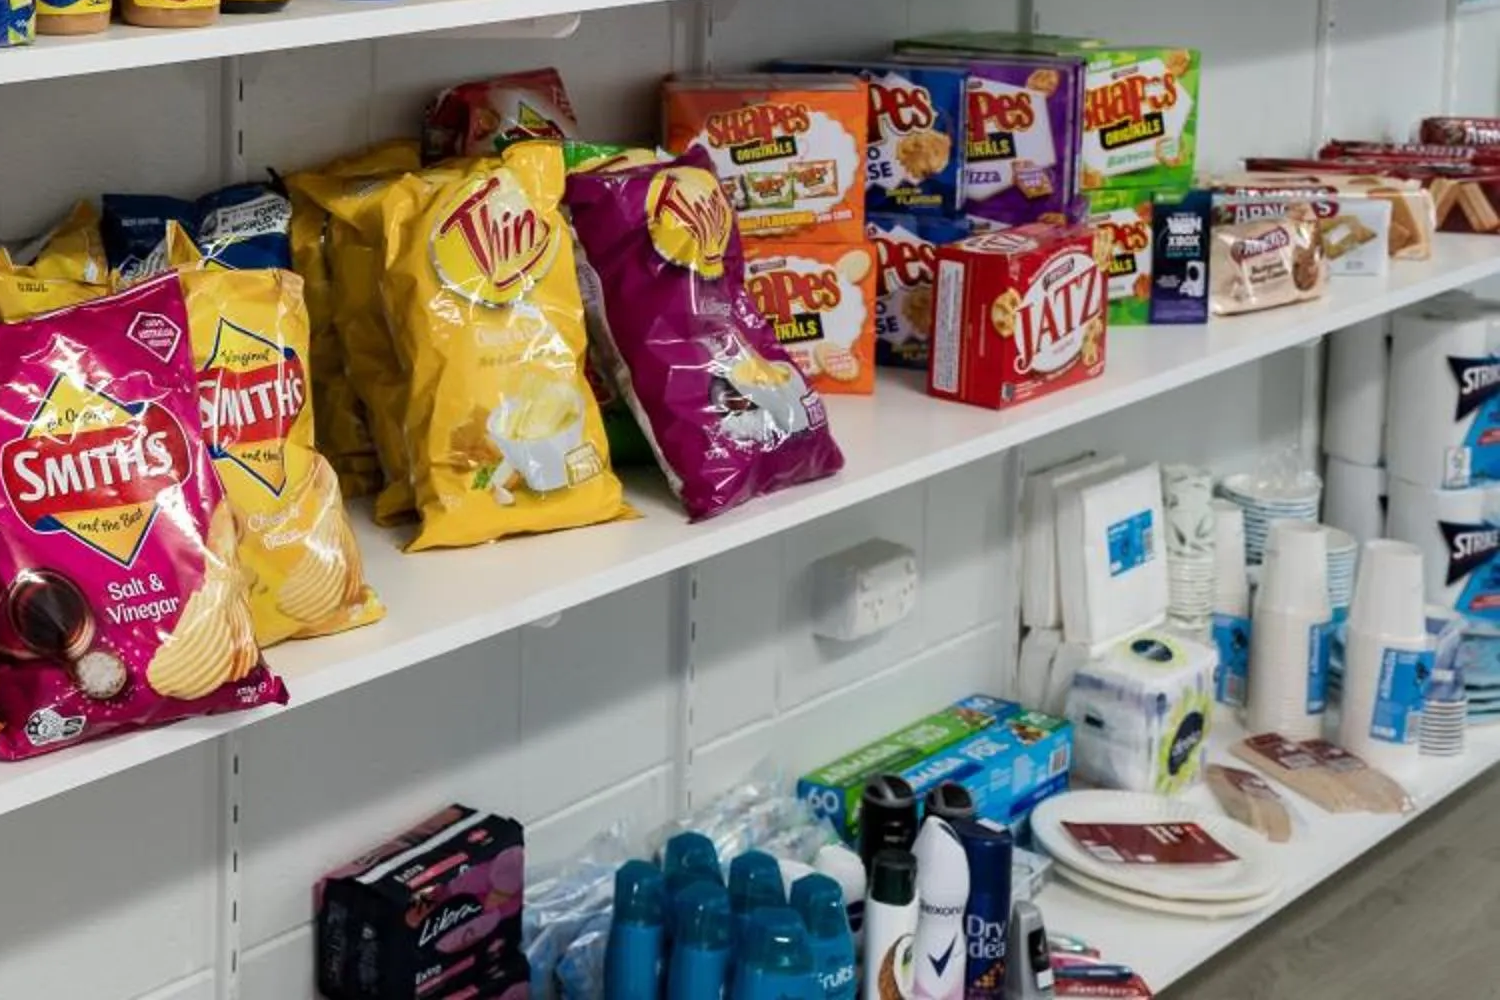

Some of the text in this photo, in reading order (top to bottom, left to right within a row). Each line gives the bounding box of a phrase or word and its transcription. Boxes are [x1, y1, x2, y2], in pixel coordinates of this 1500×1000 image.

[967, 171, 1001, 184] IZZA
[1014, 266, 1100, 374] JATZ
[77, 508, 144, 533] and the Best
[107, 576, 166, 601] Salt &
[106, 594, 182, 624] Vinegar
[808, 789, 839, 814] 60
[418, 899, 483, 947] Libra
[966, 914, 1005, 937] Dry
[970, 937, 1005, 958] dea
